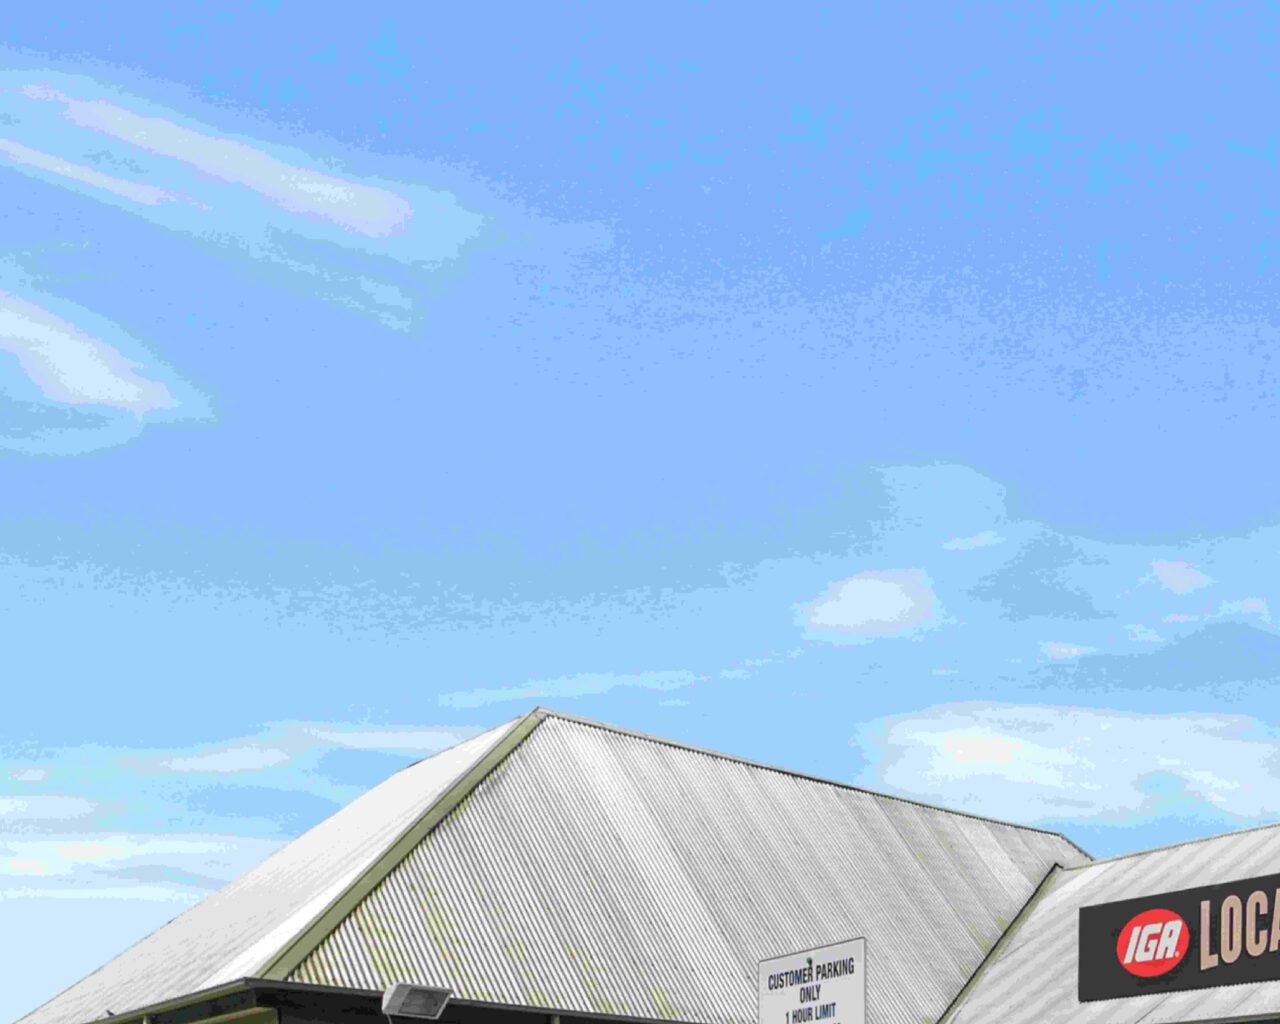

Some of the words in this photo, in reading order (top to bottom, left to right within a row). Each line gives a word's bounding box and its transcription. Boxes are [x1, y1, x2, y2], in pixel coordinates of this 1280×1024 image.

[1123, 919, 1180, 964] IGA
[768, 966, 814, 991] CUSTOMER
[816, 957, 855, 982] PARKING
[799, 984, 822, 1004] ONLY
[785, 1011, 790, 1024] 1
[792, 1006, 813, 1024] HOUR
[815, 1002, 836, 1021] LIMIT
